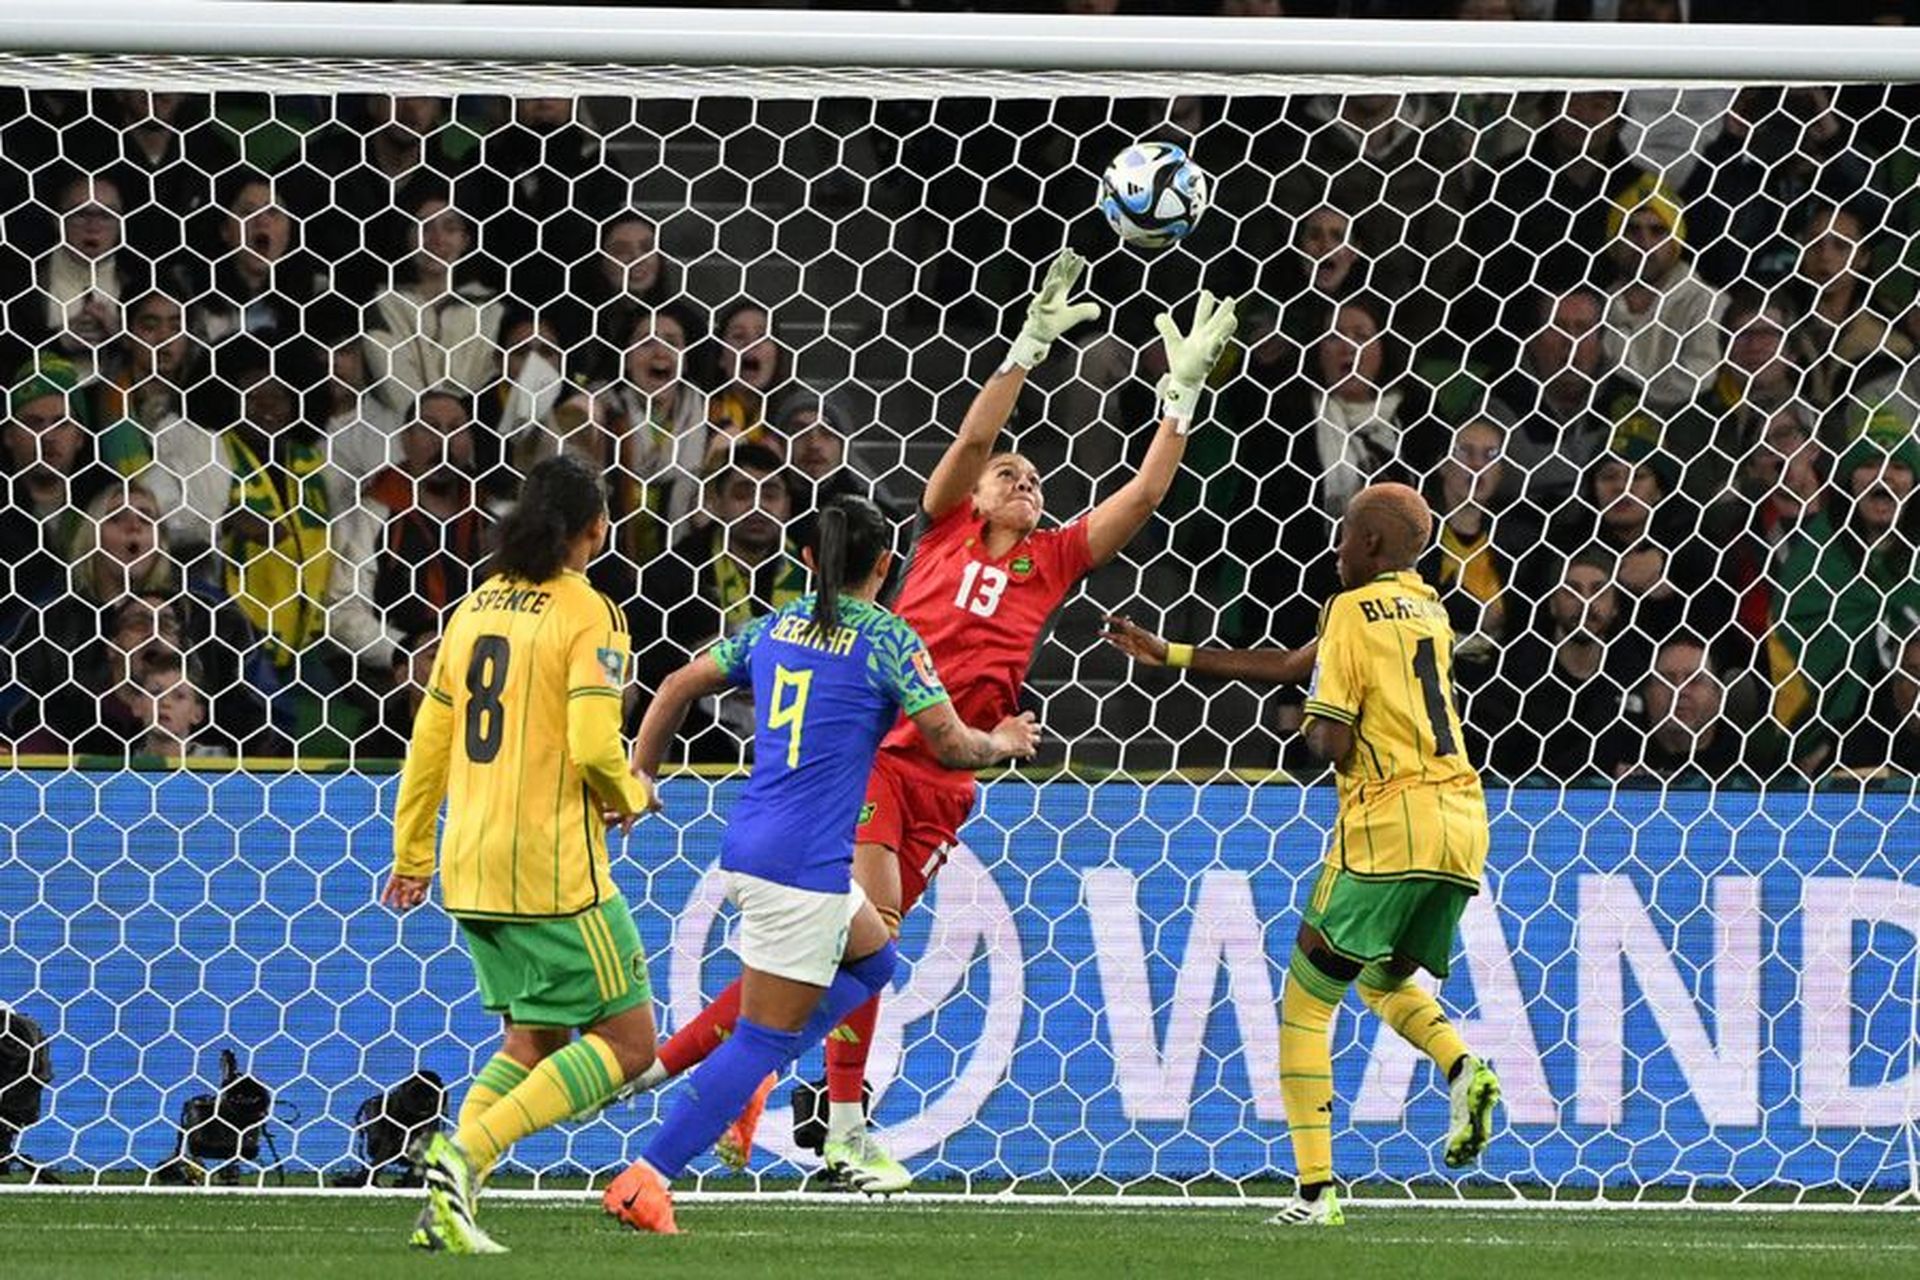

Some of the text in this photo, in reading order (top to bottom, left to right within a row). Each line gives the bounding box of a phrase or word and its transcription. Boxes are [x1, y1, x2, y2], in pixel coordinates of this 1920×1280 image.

[471, 586, 551, 614] SPENCE
[954, 560, 1008, 617] 13
[465, 635, 510, 763] 8
[768, 663, 813, 769] 9
[1412, 637, 1458, 757] 1
